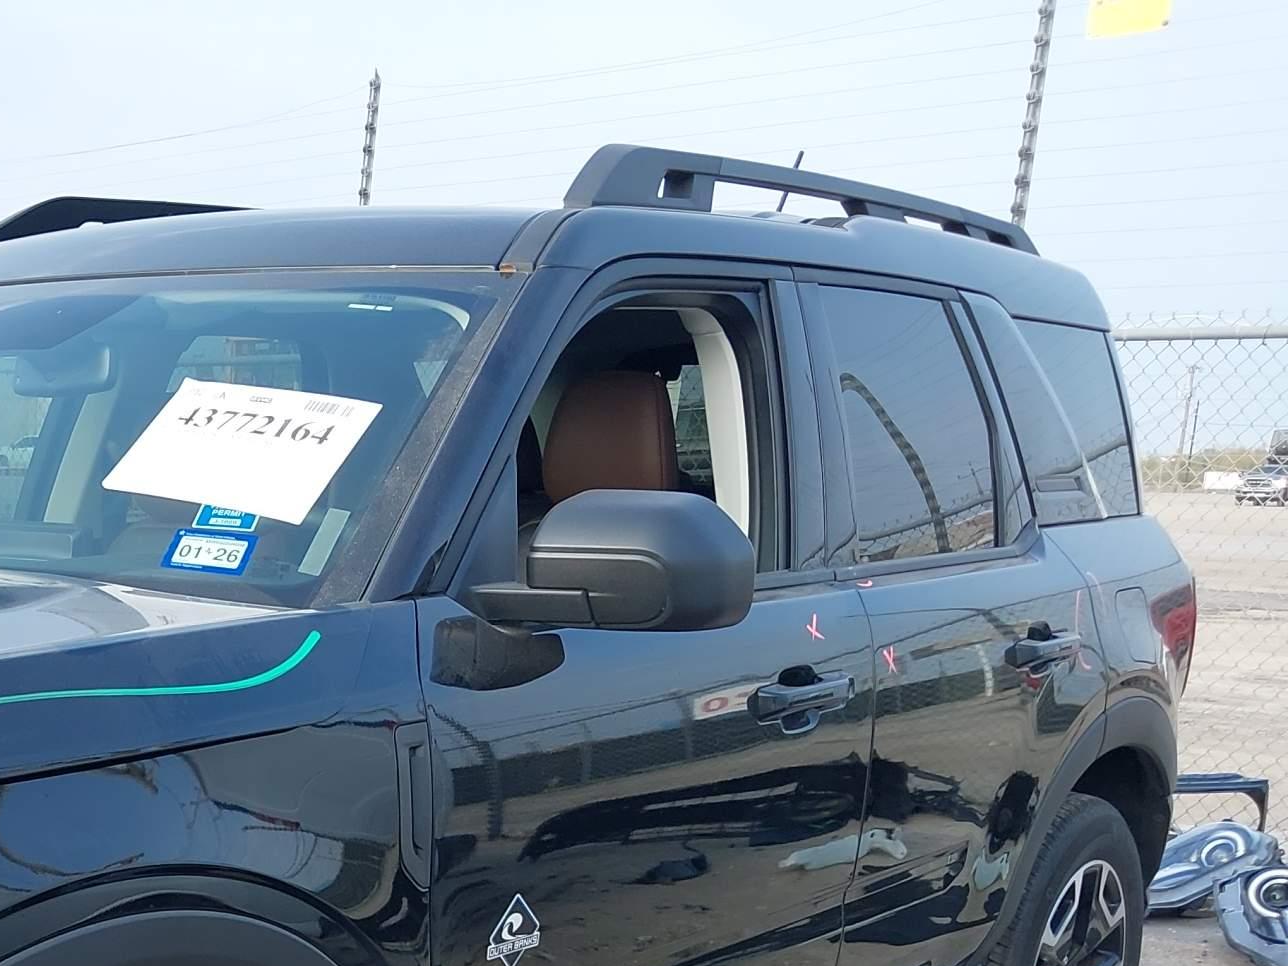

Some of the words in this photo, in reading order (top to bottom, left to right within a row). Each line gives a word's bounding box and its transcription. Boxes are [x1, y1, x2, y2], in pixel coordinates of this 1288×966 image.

[178, 406, 336, 446] 43772164
[179, 544, 203, 559] 01
[213, 547, 241, 563] 26
[489, 942, 513, 957] OUTER
[514, 935, 538, 950] BANKS
